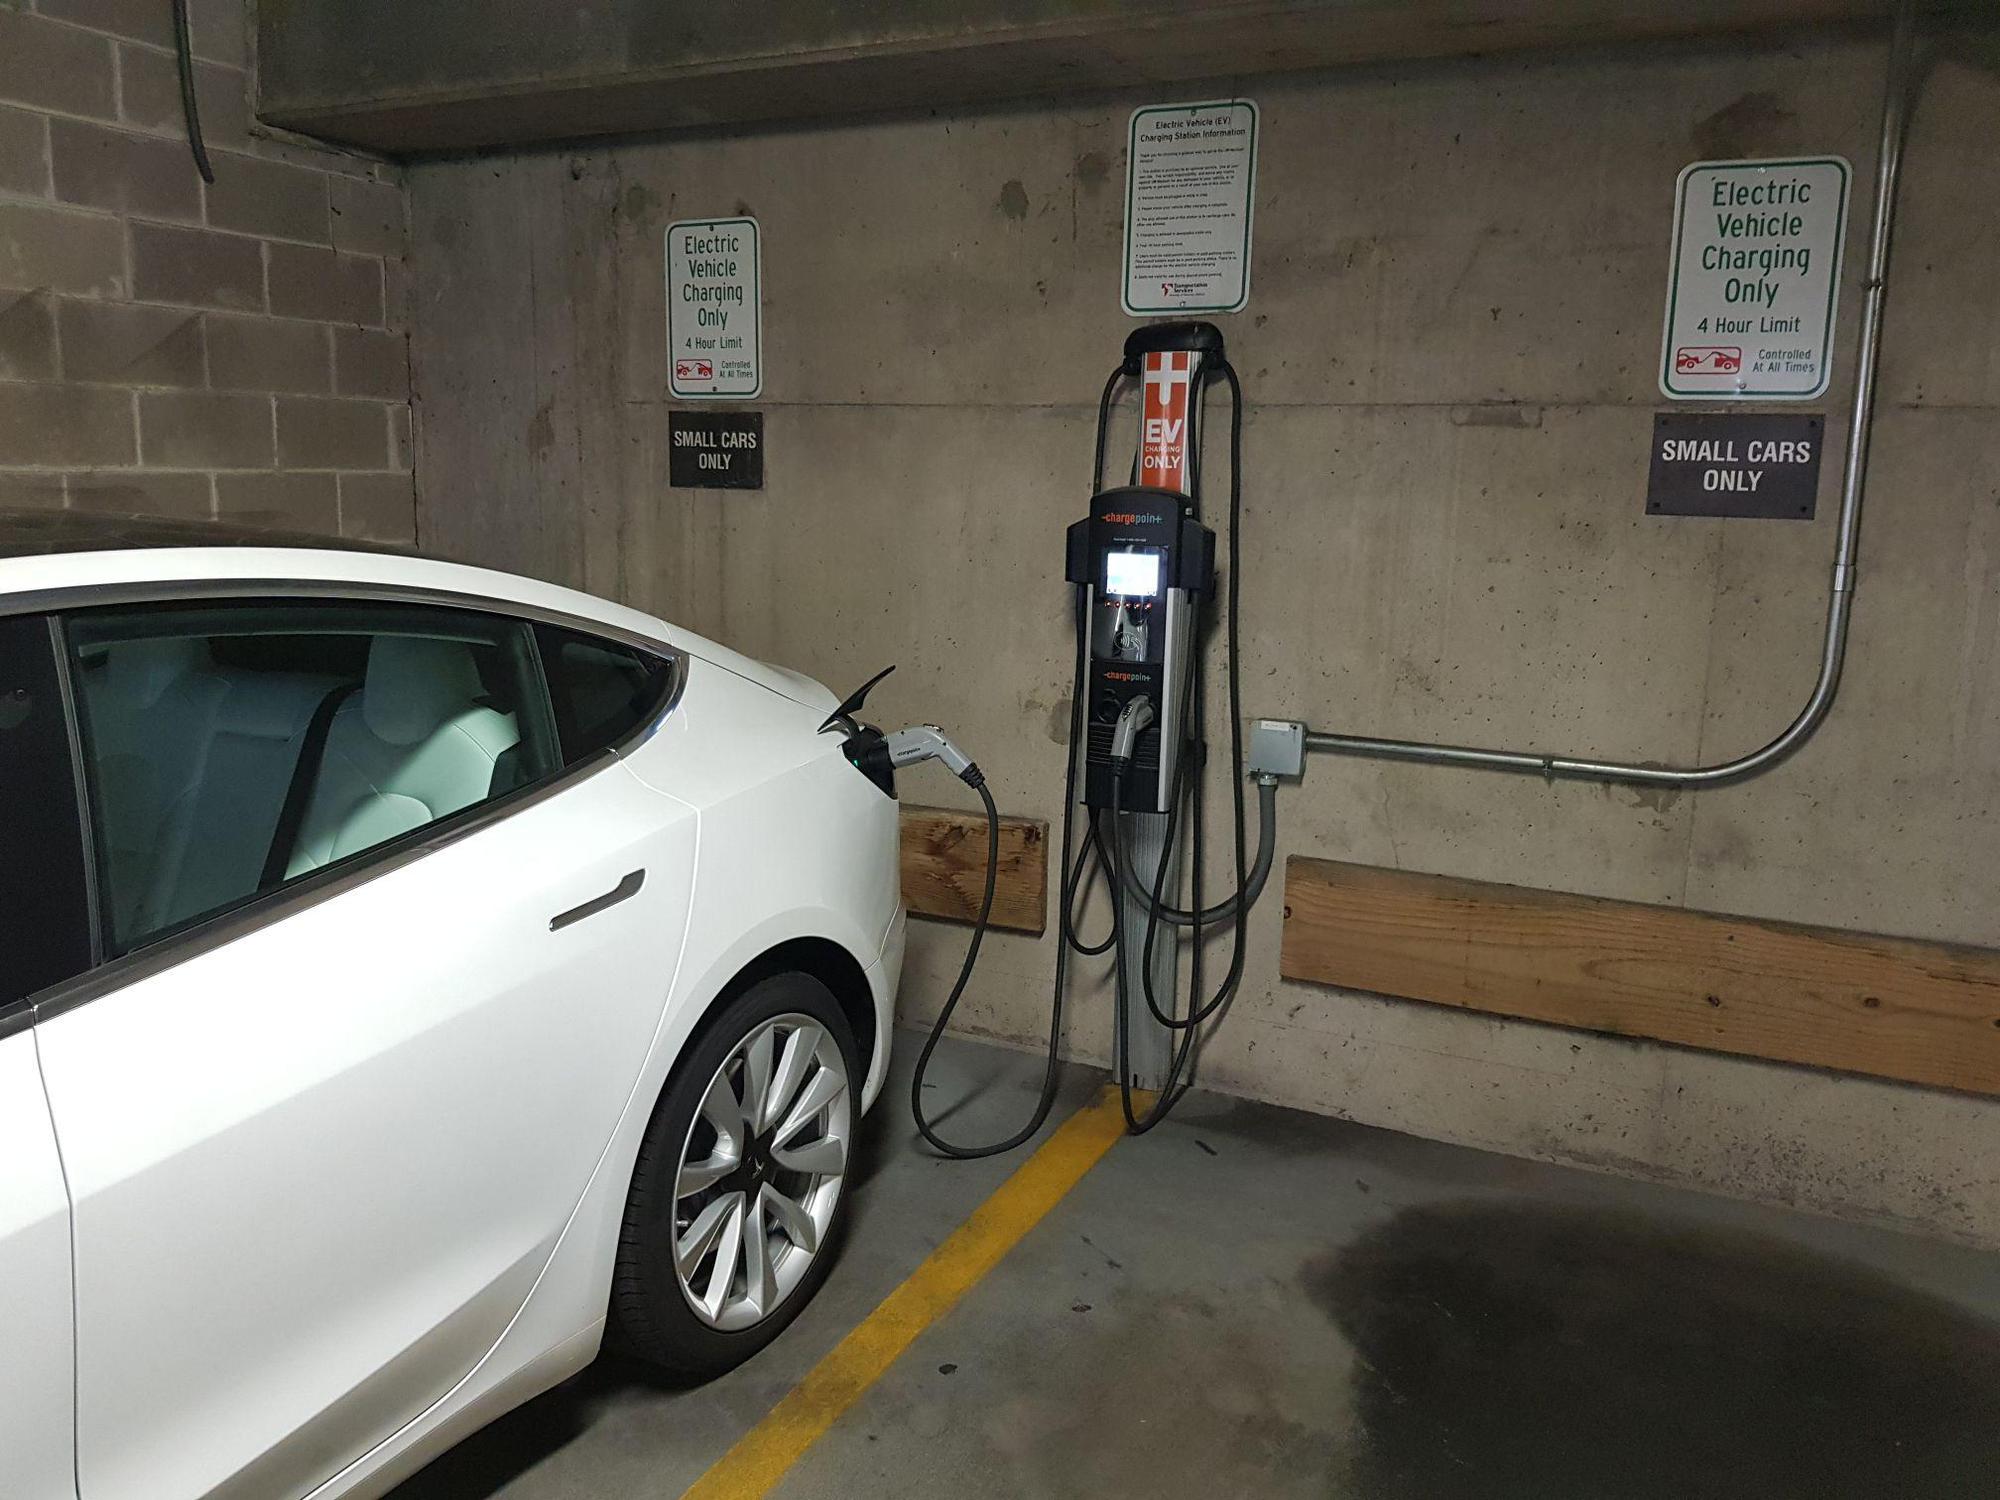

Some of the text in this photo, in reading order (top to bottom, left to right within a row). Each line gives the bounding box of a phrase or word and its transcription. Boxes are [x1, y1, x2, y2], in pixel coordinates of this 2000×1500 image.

[1155, 116, 1231, 130] Electric Vehicle (EV)
[1140, 128, 1246, 143] Charging Station Information
[1713, 181, 1811, 206] Electric
[1716, 212, 1803, 238] Vehicle
[685, 235, 739, 255] Electric
[688, 259, 737, 278] Vehicle
[1702, 245, 1811, 276] Charging
[683, 283, 743, 306] Charging
[1724, 279, 1779, 308] Only
[698, 307, 728, 330] Only
[1697, 316, 1801, 334] 4 Hour Limit
[685, 336, 743, 349] 4 Hour Limit
[1758, 349, 1812, 360] Controlled
[721, 360, 751, 369] Controlled
[1752, 362, 1815, 373] At All Times
[719, 370, 726, 378] At
[736, 370, 753, 378] Times
[1146, 418, 1183, 443] EV
[674, 431, 757, 449] SMALL CARS
[1662, 440, 1811, 464] SMALL CARS
[699, 453, 732, 470] ONLY
[1144, 455, 1181, 469] ONLY
[1703, 469, 1763, 492] ONLY
